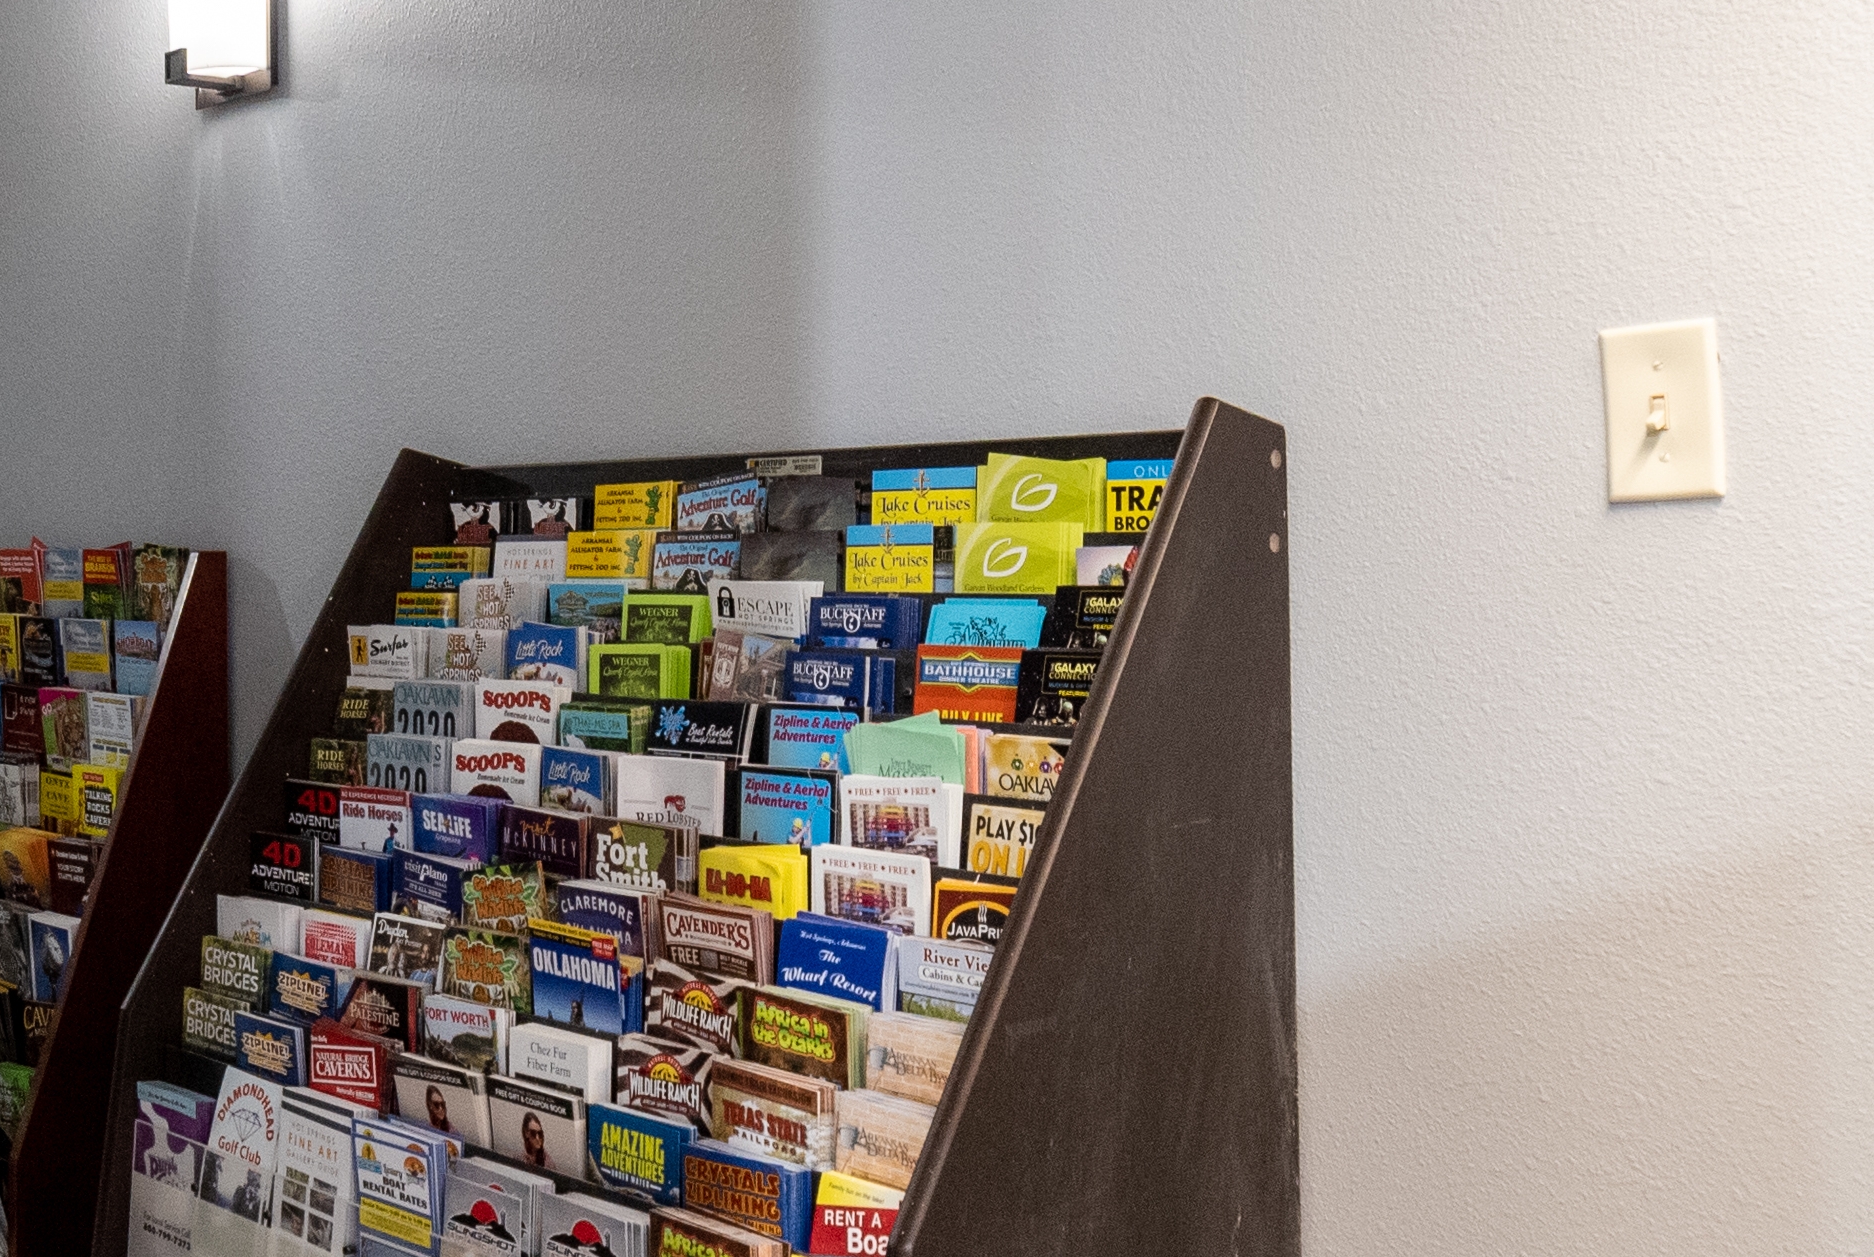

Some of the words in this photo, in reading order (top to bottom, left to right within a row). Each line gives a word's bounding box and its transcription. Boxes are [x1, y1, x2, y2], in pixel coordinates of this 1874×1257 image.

[680, 497, 728, 519] Adventure
[731, 489, 756, 507] Golf
[877, 497, 909, 517] Lake
[913, 496, 971, 514] Cruises
[1111, 485, 1163, 512] TRA
[504, 559, 527, 570] FINE
[535, 559, 555, 569] ART
[657, 551, 705, 569] Adventure
[708, 549, 734, 568] Golf
[477, 584, 495, 600] SEE
[483, 601, 499, 615] HOT
[639, 608, 678, 617] WEGNER
[737, 597, 794, 617] ESCAPE
[820, 607, 886, 620] BUCKSTAFF
[759, 616, 794, 625] SPRINGS
[453, 653, 470, 666] HOT
[515, 639, 537, 660] Little
[536, 640, 564, 659] Rock
[793, 663, 854, 679] BUCKSTAFF
[925, 664, 1016, 679] BATHHOUSE
[1055, 662, 1096, 673] GALAXY
[938, 675, 965, 683] DINNER
[968, 677, 1000, 685] THEATRE
[41, 704, 52, 715] GO
[342, 699, 369, 710] RIDE
[483, 689, 551, 713] SCOOPS
[340, 710, 367, 719] HORSES
[773, 715, 809, 729] Zipline
[812, 717, 820, 728] &
[773, 728, 836, 744] Adventures
[455, 752, 525, 773] SCOOPS
[745, 778, 781, 793] Zipline
[782, 784, 791, 793] &
[793, 786, 829, 798] Aerial
[854, 788, 874, 796] FREE
[882, 787, 901, 796] FREE
[911, 787, 930, 795] FREE
[999, 773, 1057, 794] OAKLA
[85, 789, 112, 802] TALKING
[298, 789, 337, 815] 4D
[744, 793, 808, 810] Adventures
[87, 802, 110, 813] ROCKS
[343, 803, 365, 818] Ride
[368, 807, 403, 823] Horses
[422, 809, 445, 831] SEA
[636, 812, 664, 823] RED
[667, 810, 702, 830] LOBSTER
[976, 816, 1015, 840] PLAY
[262, 841, 301, 868] 4D
[596, 832, 648, 869] Fort
[971, 840, 1010, 876] ON
[596, 862, 667, 891] Smith
[561, 899, 634, 925] CLAREMORE
[667, 912, 750, 950] CAVENDER'S
[205, 947, 259, 973] CRYSTAL
[819, 949, 841, 965] The
[923, 947, 960, 969] River
[964, 950, 990, 972] Vie
[204, 965, 259, 992] BRIDGES
[533, 946, 615, 991] OKLAHOMA
[923, 968, 953, 983] Cabins
[956, 975, 964, 983] &
[278, 975, 326, 998] ZIPLINE!
[781, 966, 829, 986] Wharf
[830, 972, 876, 1003] Resort
[350, 1006, 400, 1027] PALESTINE
[425, 1007, 448, 1022] FORT
[450, 1009, 490, 1028] WORTH
[663, 993, 699, 1027] WILDLIFE
[701, 1011, 732, 1043] RANCH
[755, 1001, 810, 1036] Africa
[813, 1019, 828, 1038] in
[530, 1042, 550, 1055] Chez
[553, 1045, 567, 1060] Fur
[753, 1023, 776, 1041] the
[778, 1028, 834, 1060] Ozarks
[316, 1052, 343, 1062] NATURAL
[345, 1054, 368, 1064] BRIDGE
[316, 1060, 370, 1080] CAVERNS
[630, 1073, 667, 1100] WILDLIFE
[668, 1081, 700, 1108] RANCH
[218, 1083, 274, 1141] DIAMONDHEAD
[723, 1101, 764, 1132] TEXAS
[766, 1113, 808, 1147] STATE
[218, 1135, 237, 1157] Golf
[240, 1145, 261, 1165] Club
[288, 1133, 312, 1152] FINE
[318, 1146, 338, 1163] ART
[601, 1121, 664, 1165] AMAZING
[601, 1148, 665, 1185] ADVENTURES
[685, 1156, 781, 1197] CRYSTALS
[363, 1180, 397, 1200] RENTAL
[400, 1191, 428, 1210] RATES
[382, 1177, 406, 1192] BOAT
[685, 1179, 781, 1221] ZIPLINING
[825, 1209, 865, 1228] RENT
[871, 1212, 882, 1229] A
[447, 1221, 517, 1254] SLINGSHOT
[846, 1227, 889, 1256] Boa
